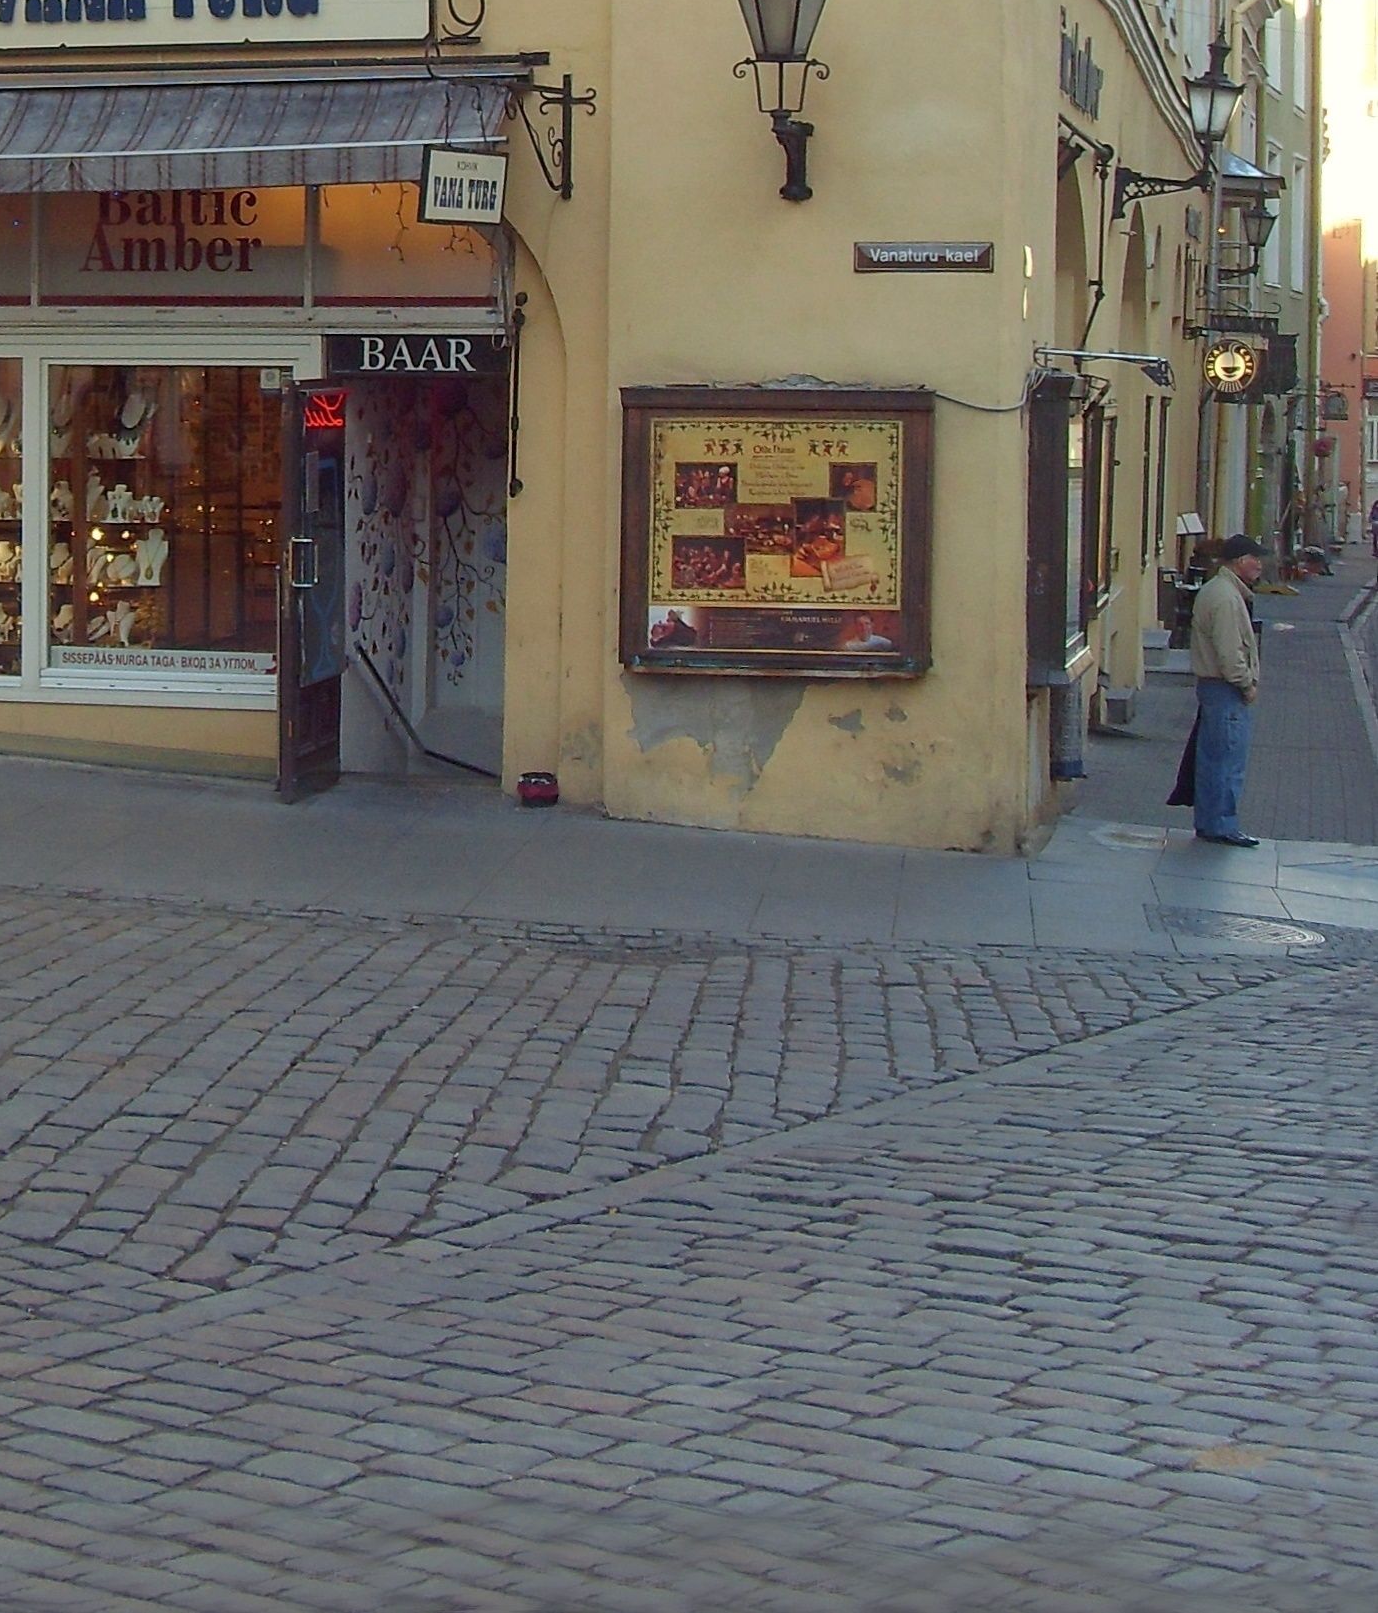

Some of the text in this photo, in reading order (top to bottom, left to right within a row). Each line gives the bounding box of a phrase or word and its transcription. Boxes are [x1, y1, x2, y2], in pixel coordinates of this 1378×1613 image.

[98, 188, 258, 227] Baltic
[433, 175, 498, 211] VANA TURG
[78, 222, 263, 272] Amber
[869, 247, 979, 263] Vanaturu kael
[358, 336, 477, 373] BAAR
[151, 654, 176, 668] TAGA
[181, 654, 207, 669] ВХОД
[209, 655, 221, 669] ЗА
